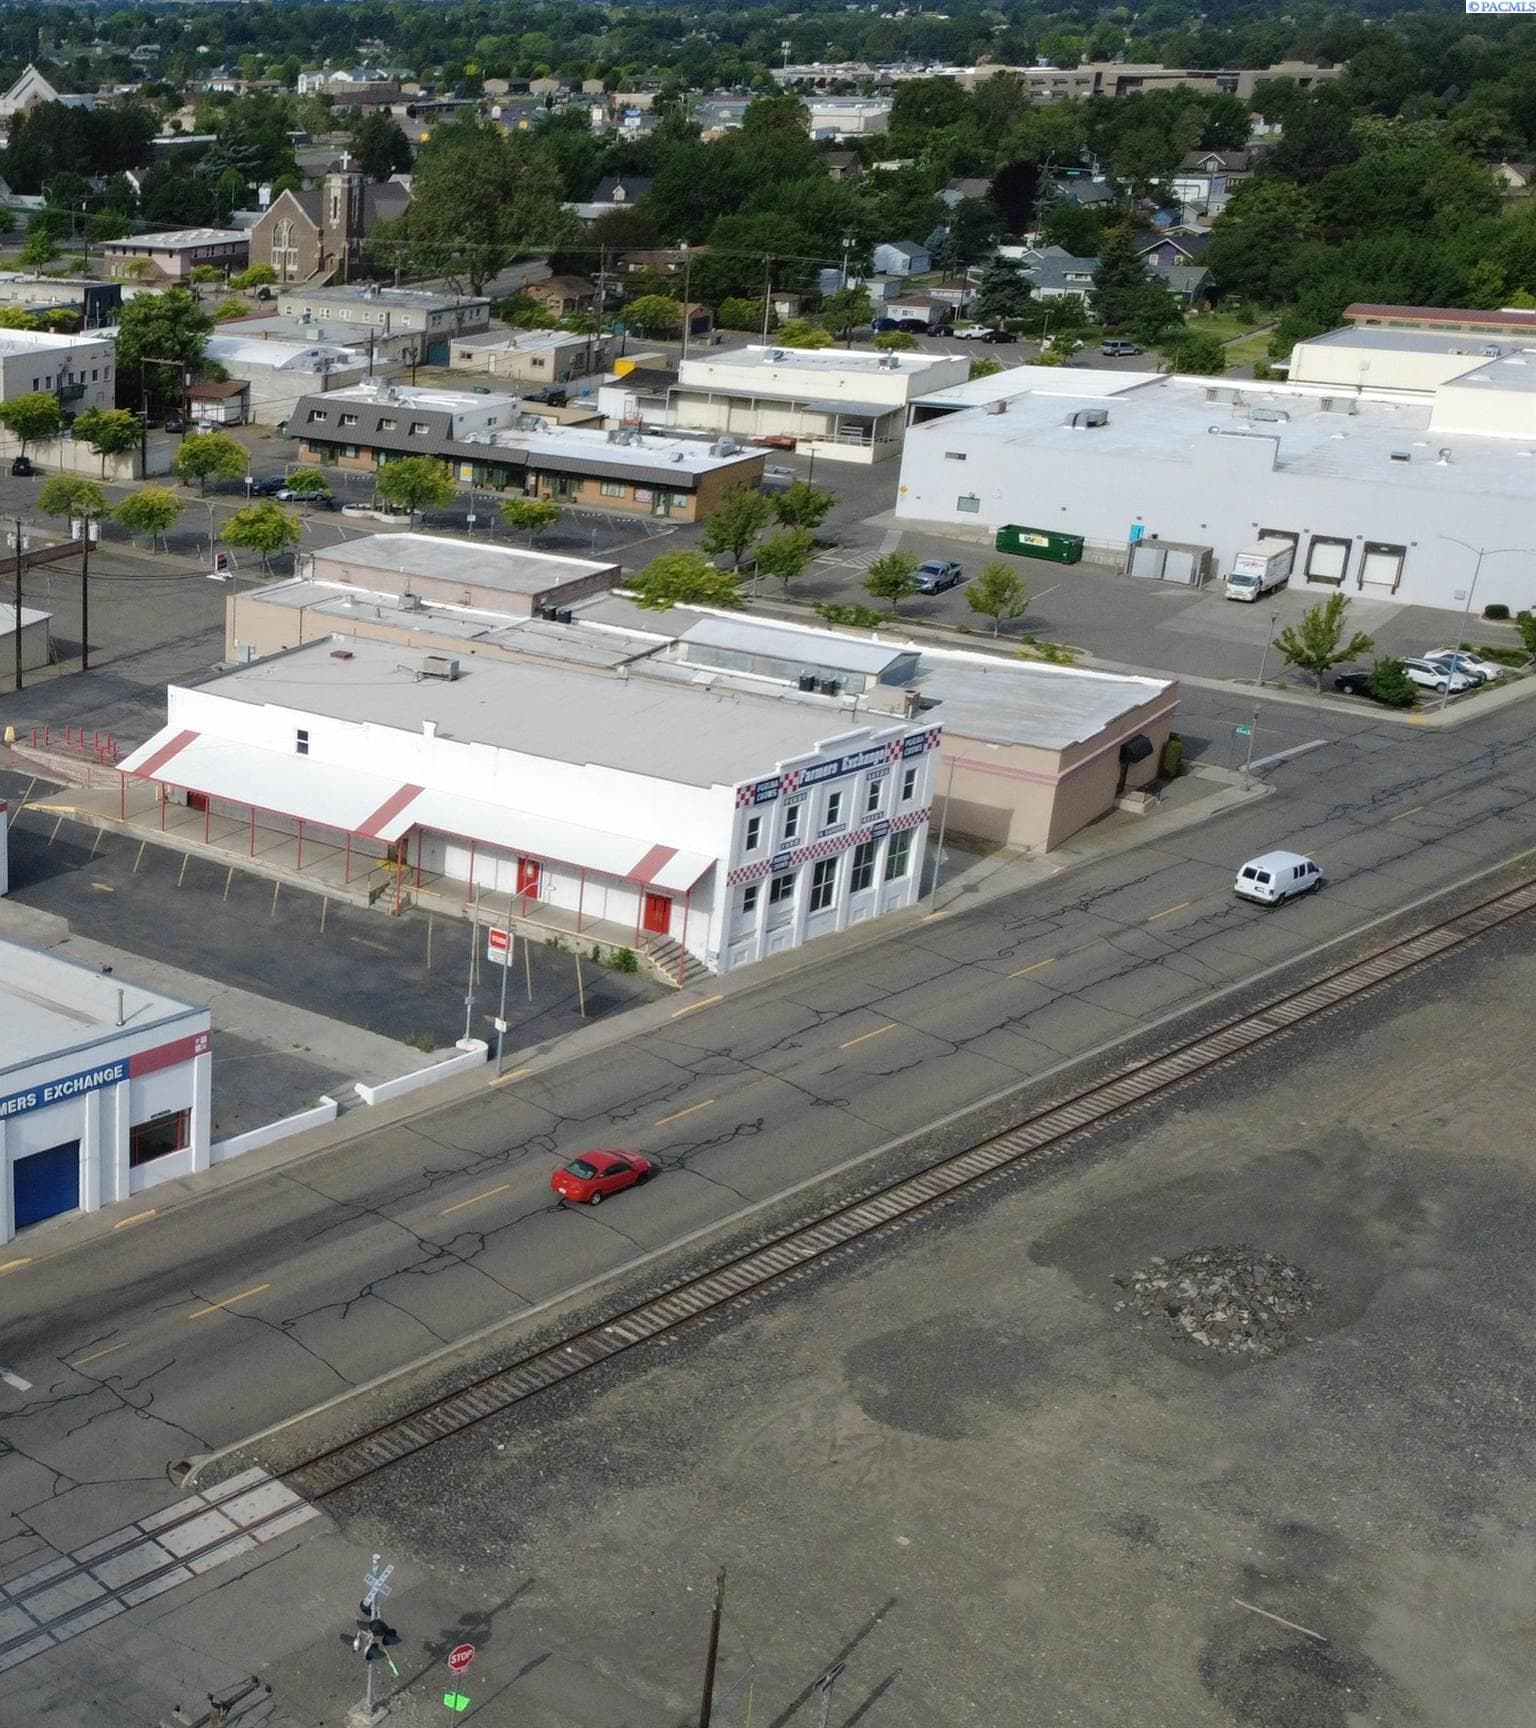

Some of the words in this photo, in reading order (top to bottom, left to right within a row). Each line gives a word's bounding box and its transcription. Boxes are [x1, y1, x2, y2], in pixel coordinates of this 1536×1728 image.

[800, 763, 838, 783] Farmers
[842, 749, 891, 771] Exchange
[43, 1064, 124, 1103] EXCHANGE
[450, 1648, 473, 1665] STOP
